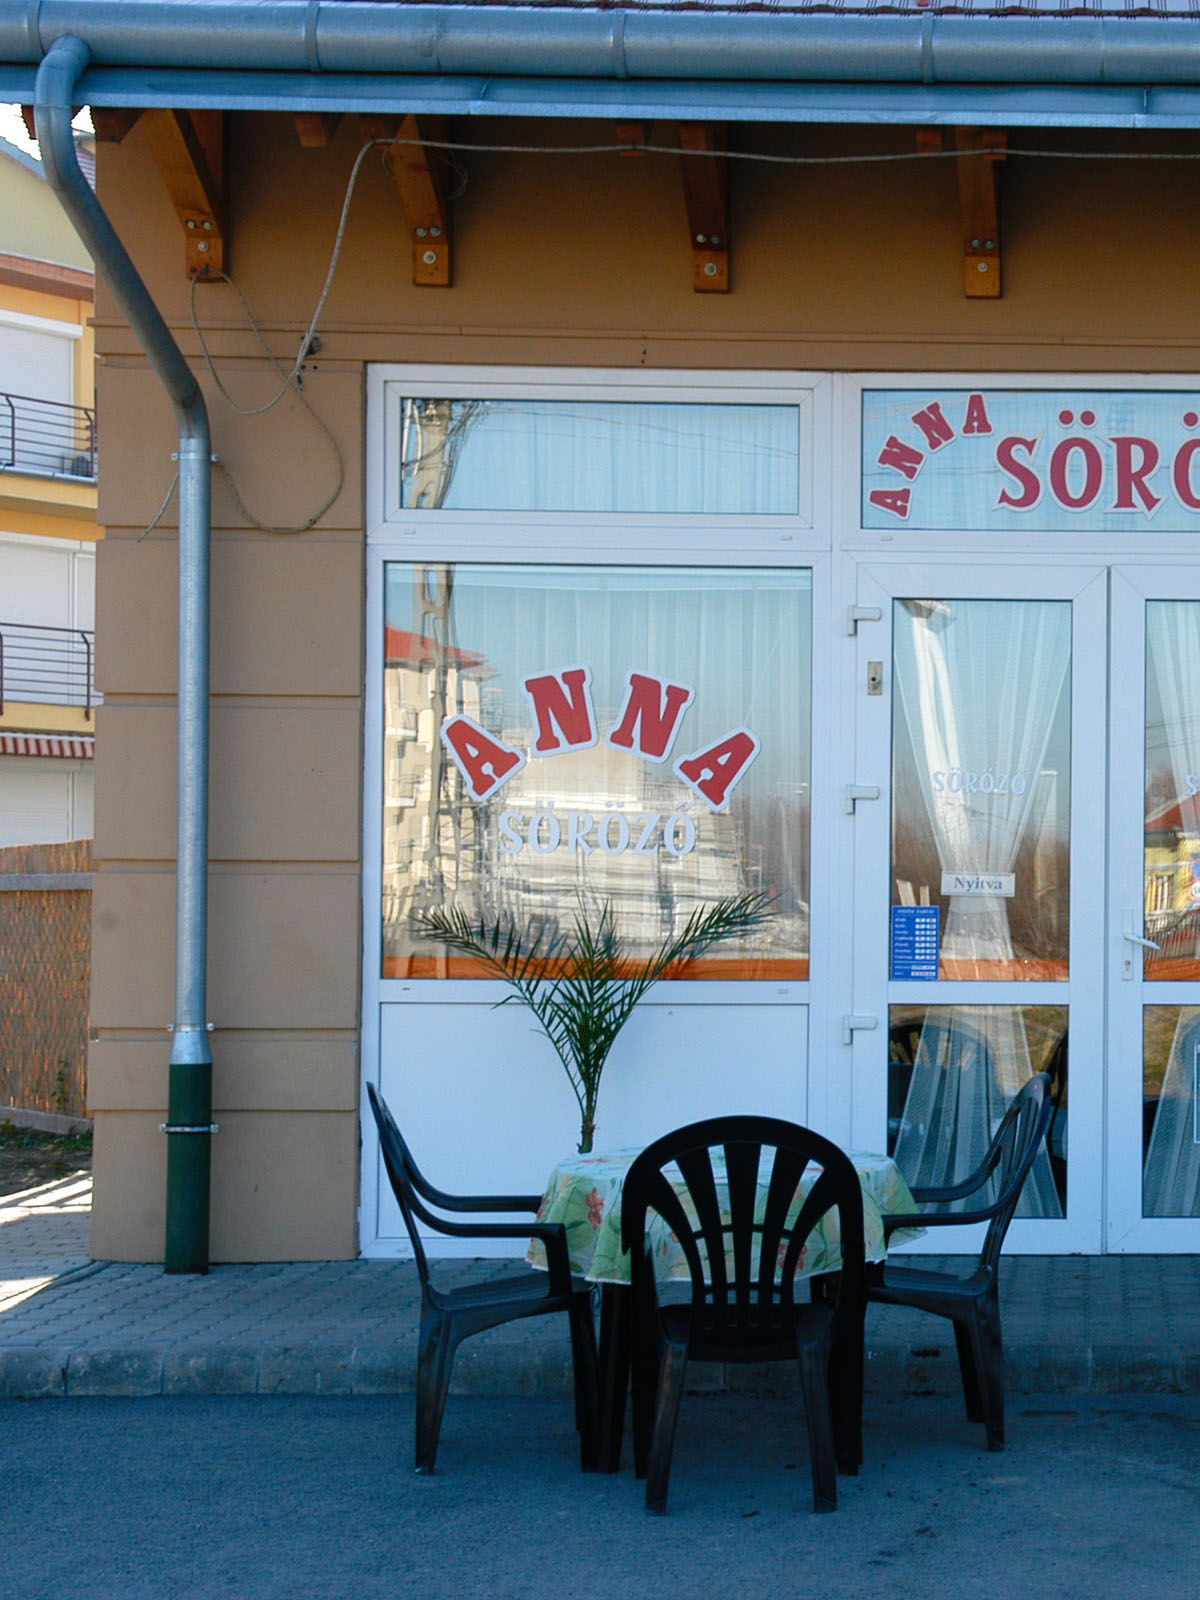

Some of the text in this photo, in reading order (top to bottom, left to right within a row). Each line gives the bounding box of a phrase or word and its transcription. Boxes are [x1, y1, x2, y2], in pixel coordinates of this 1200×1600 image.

[868, 393, 993, 518] ANNA
[443, 666, 758, 808] ANNA
[932, 767, 1029, 796] SÖRÖZŐ
[499, 800, 696, 856] SÖRÖZŐ
[954, 876, 1003, 892] Nyitva
